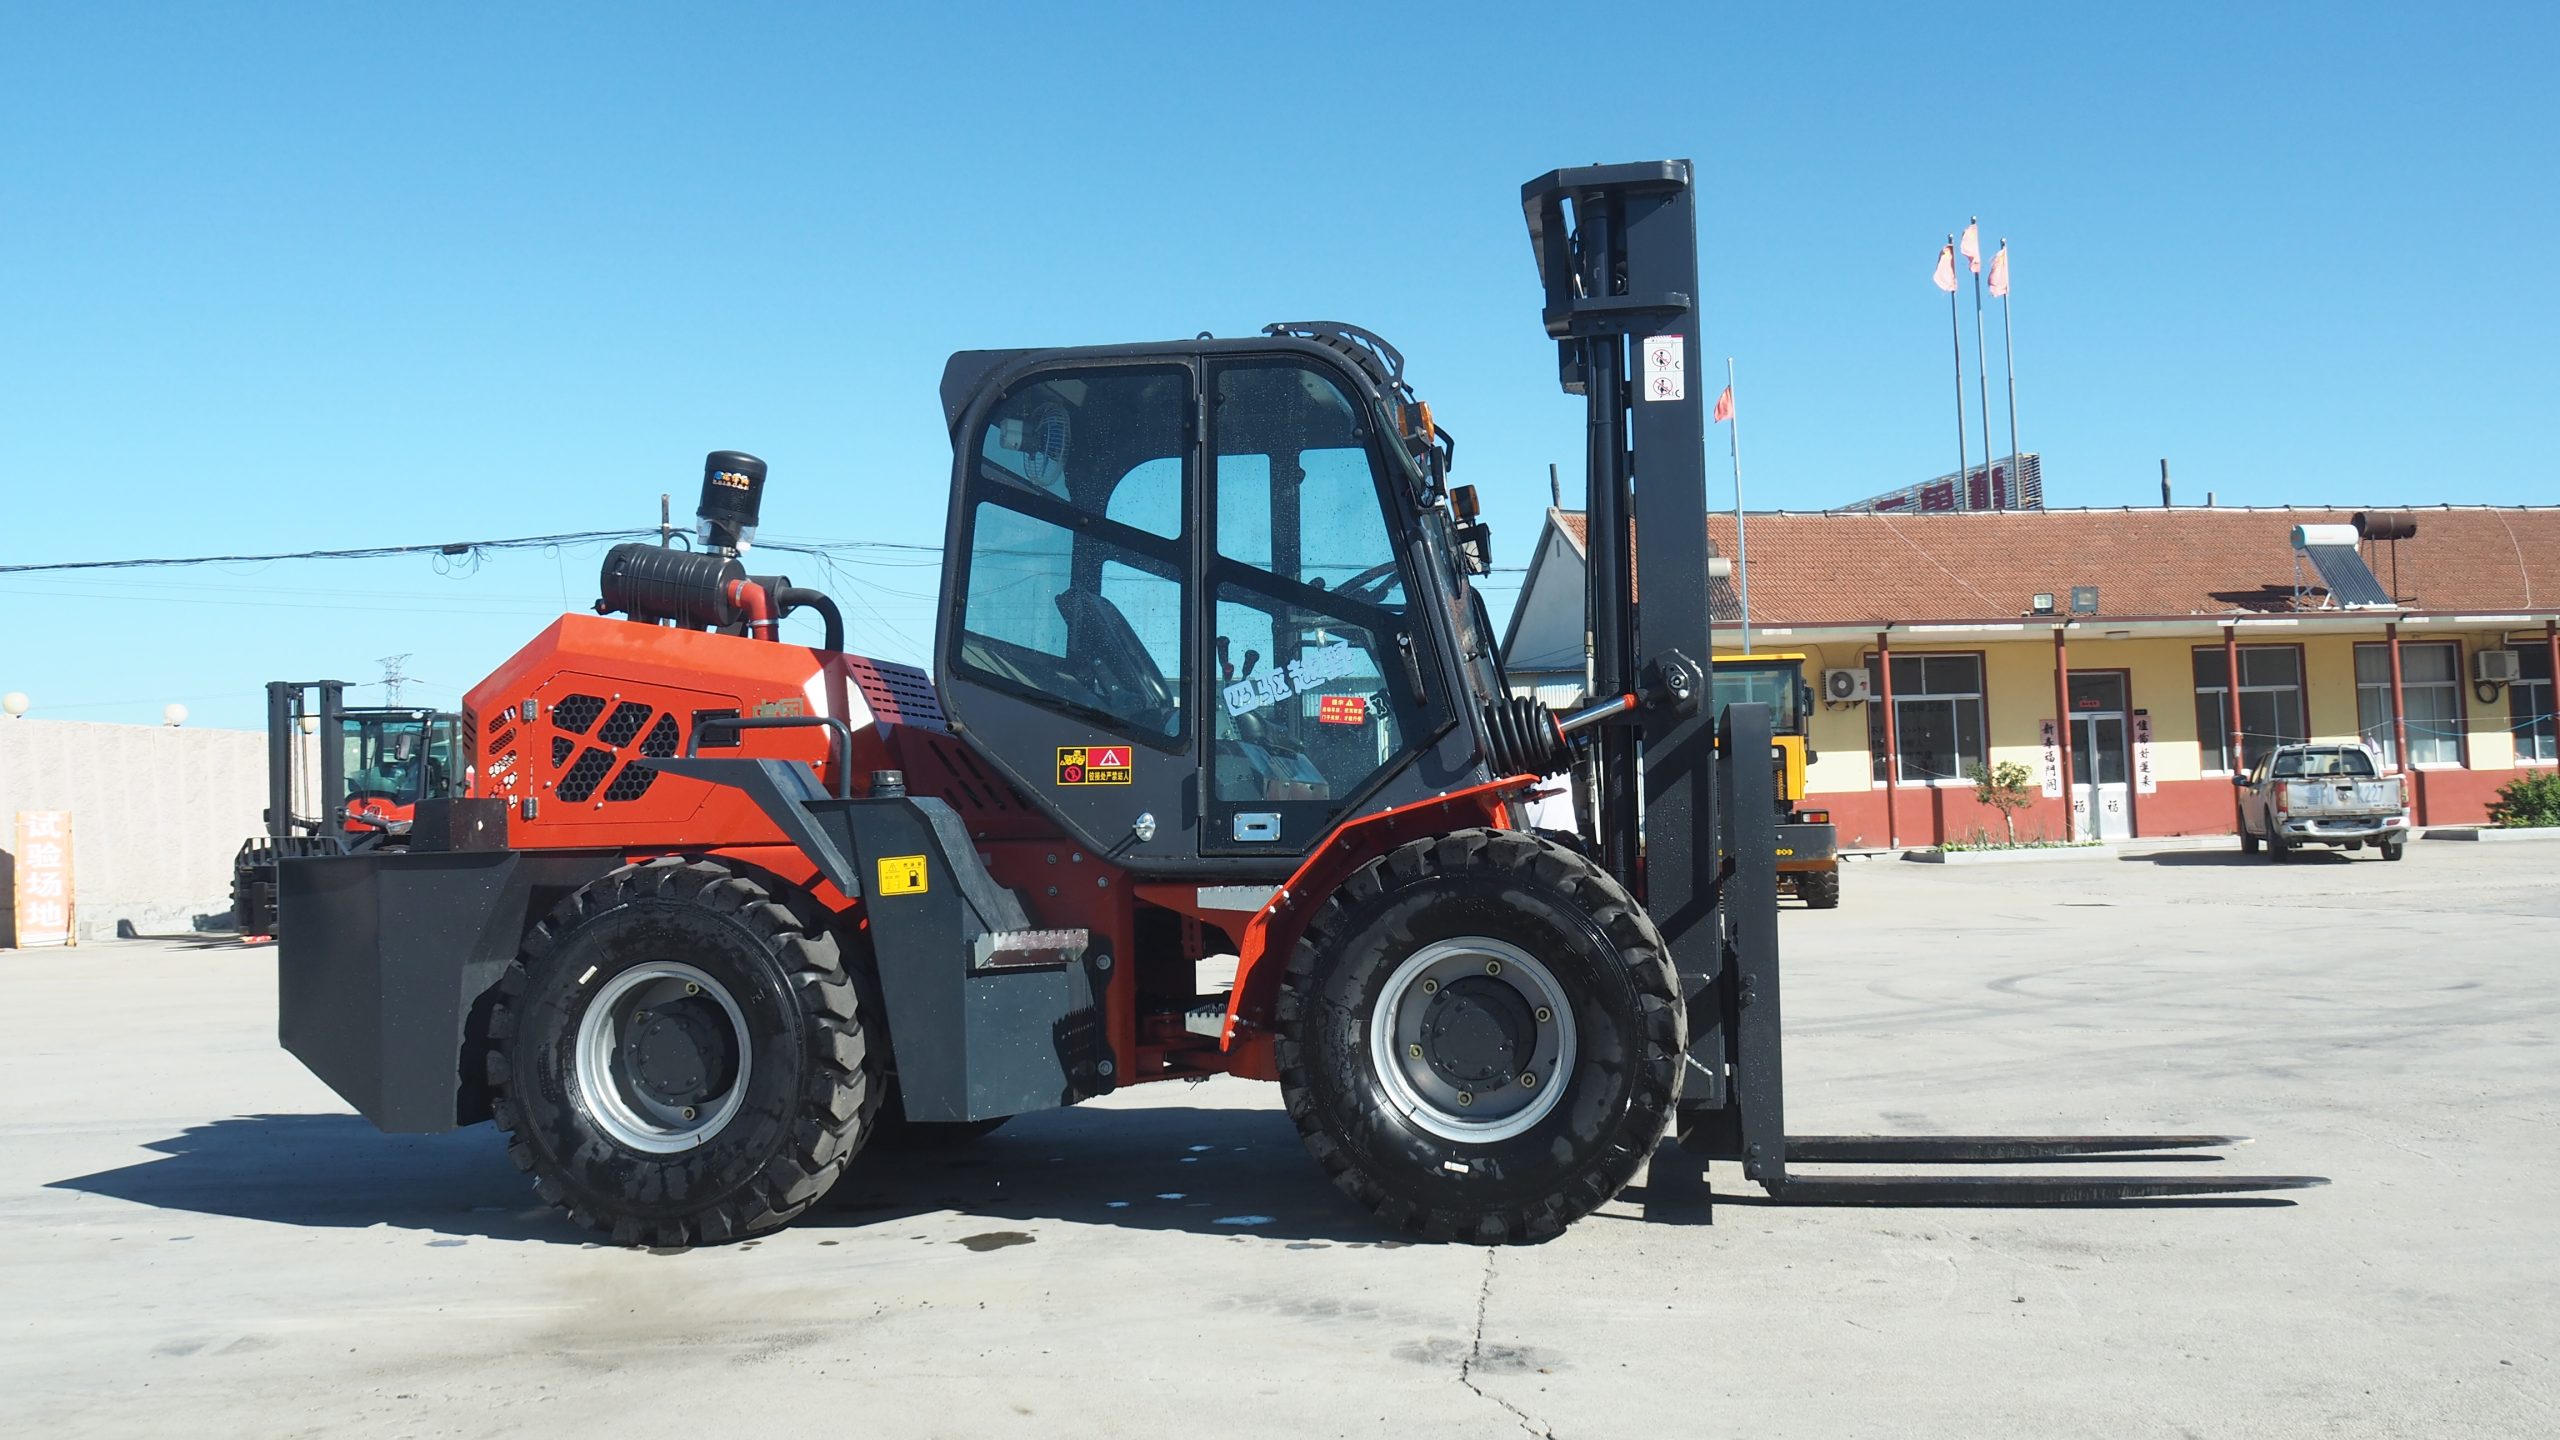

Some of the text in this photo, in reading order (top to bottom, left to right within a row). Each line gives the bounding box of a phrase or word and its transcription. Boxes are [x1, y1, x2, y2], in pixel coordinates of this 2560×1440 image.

[1223, 640, 1353, 717] 四驱越野
[1088, 771, 1129, 781] 铰接处严禁站人
[2074, 800, 2085, 813] 福
[2108, 800, 2119, 813] 福
[26, 811, 63, 926] 试验场地
